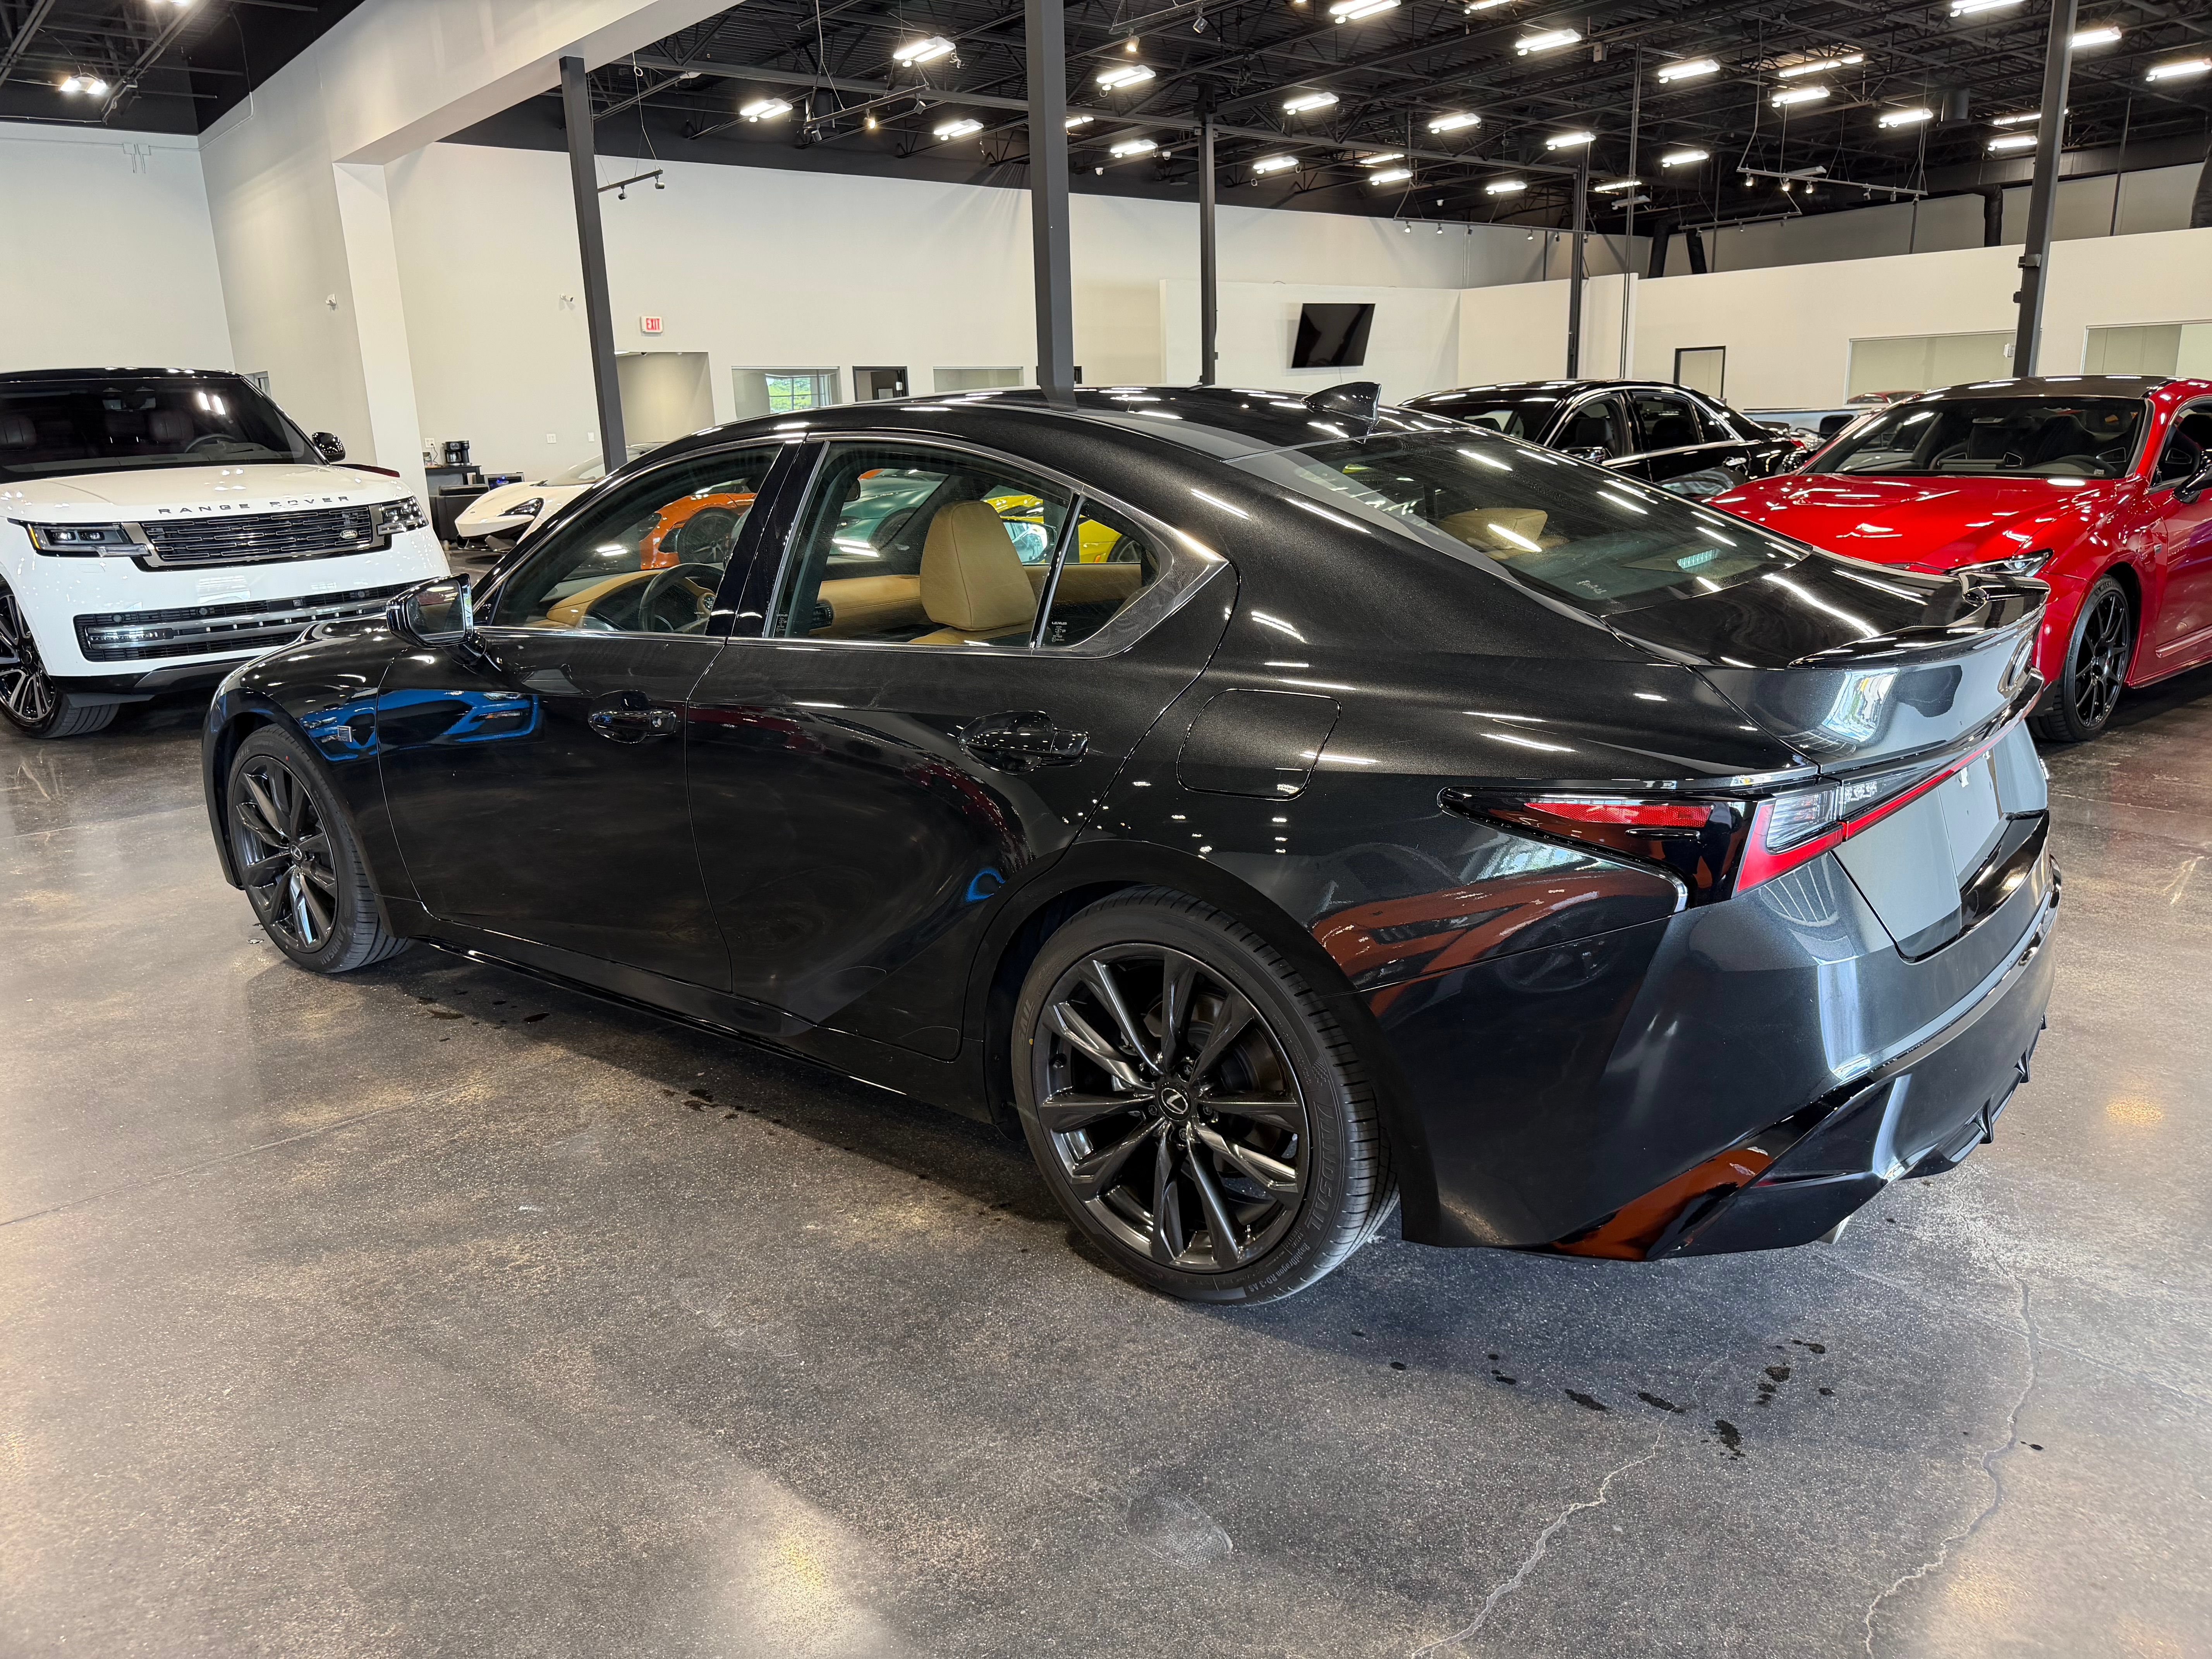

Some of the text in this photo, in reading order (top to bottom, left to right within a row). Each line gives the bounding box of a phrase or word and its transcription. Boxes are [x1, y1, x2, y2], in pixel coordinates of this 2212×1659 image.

[646, 318, 659, 330] EXIT
[158, 496, 349, 514] RANGE ROVER
